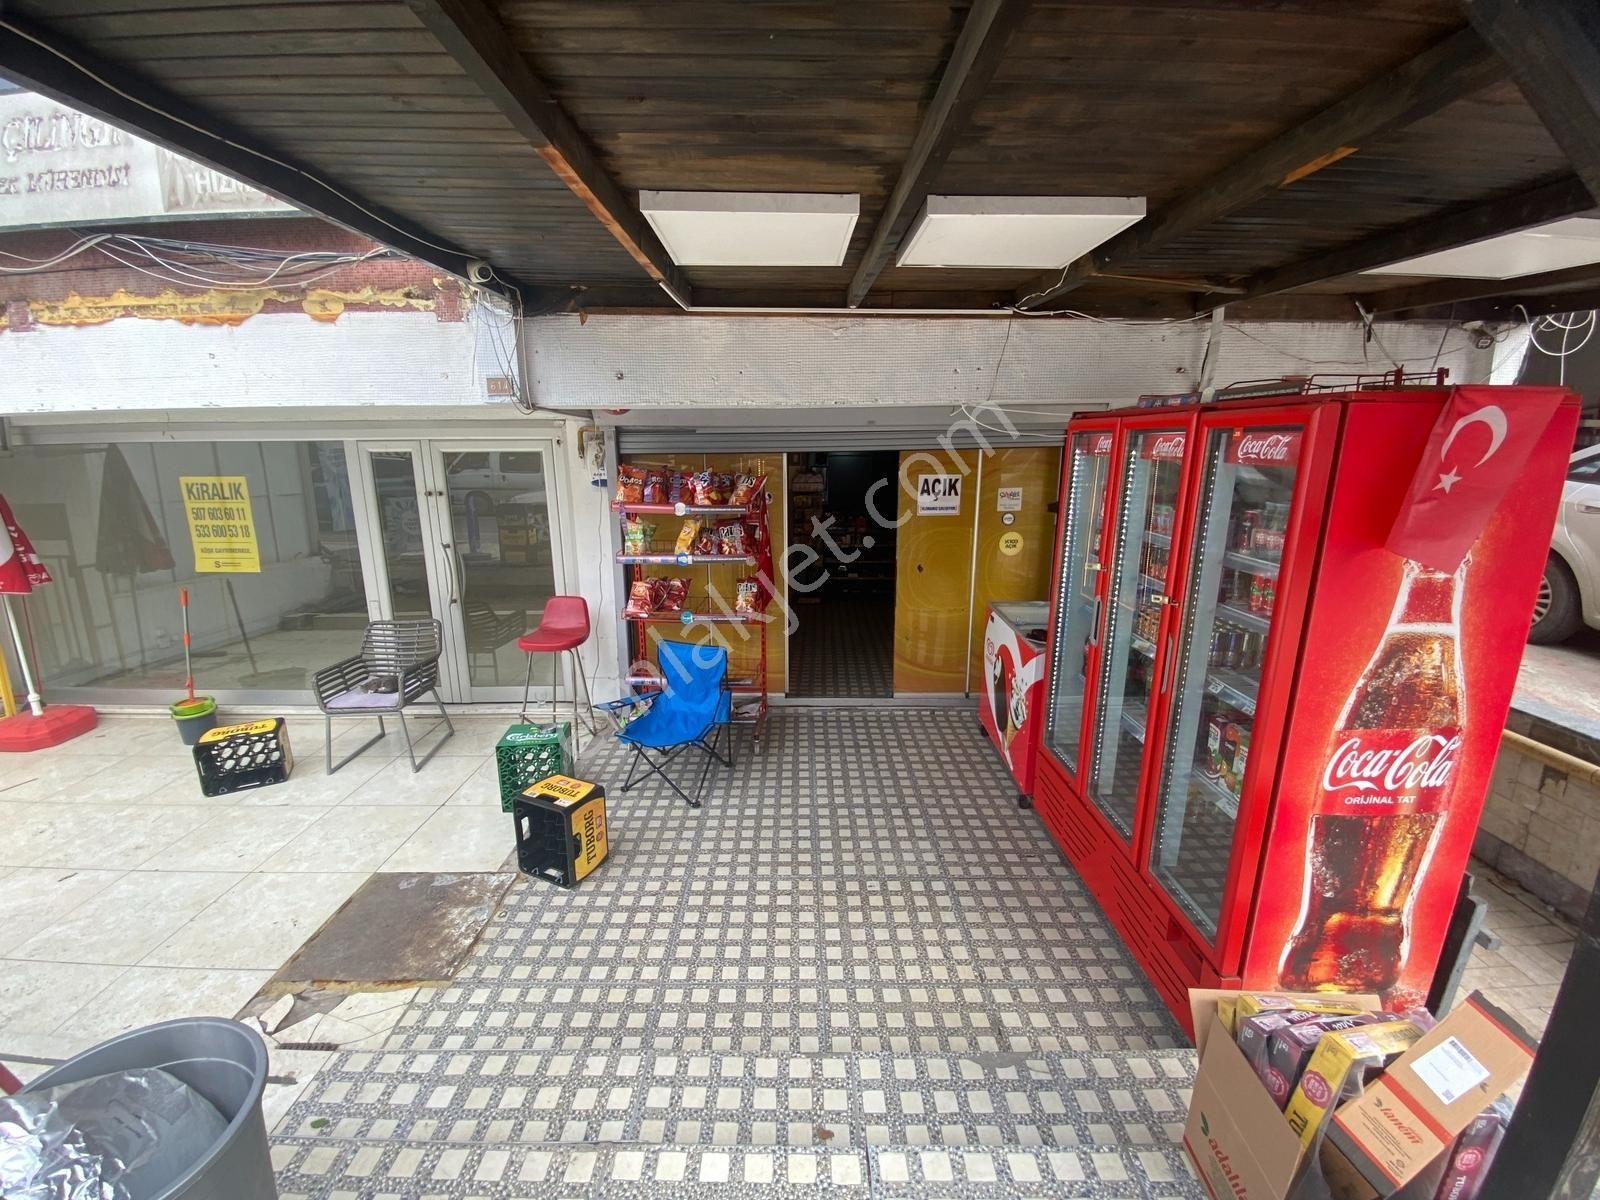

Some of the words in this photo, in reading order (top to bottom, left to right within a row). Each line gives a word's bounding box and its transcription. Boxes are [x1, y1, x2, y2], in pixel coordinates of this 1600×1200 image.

[1238, 434, 1294, 459] Coca-Cola
[920, 478, 960, 501] AÇIK
[191, 507, 207, 521] 507
[207, 507, 224, 521] 603
[224, 507, 236, 521] 60
[236, 507, 247, 521] 11
[195, 525, 211, 538] 533
[211, 525, 227, 538] 600
[227, 525, 240, 538] 53
[240, 525, 251, 538] 18
[506, 731, 559, 741] Carlsberg
[1322, 734, 1463, 792] Coca-Cola
[540, 782, 580, 798] TUBORG
[1344, 794, 1394, 805] ORİJİNAL
[1397, 795, 1416, 804] TAT
[583, 809, 597, 865] TUBORG
